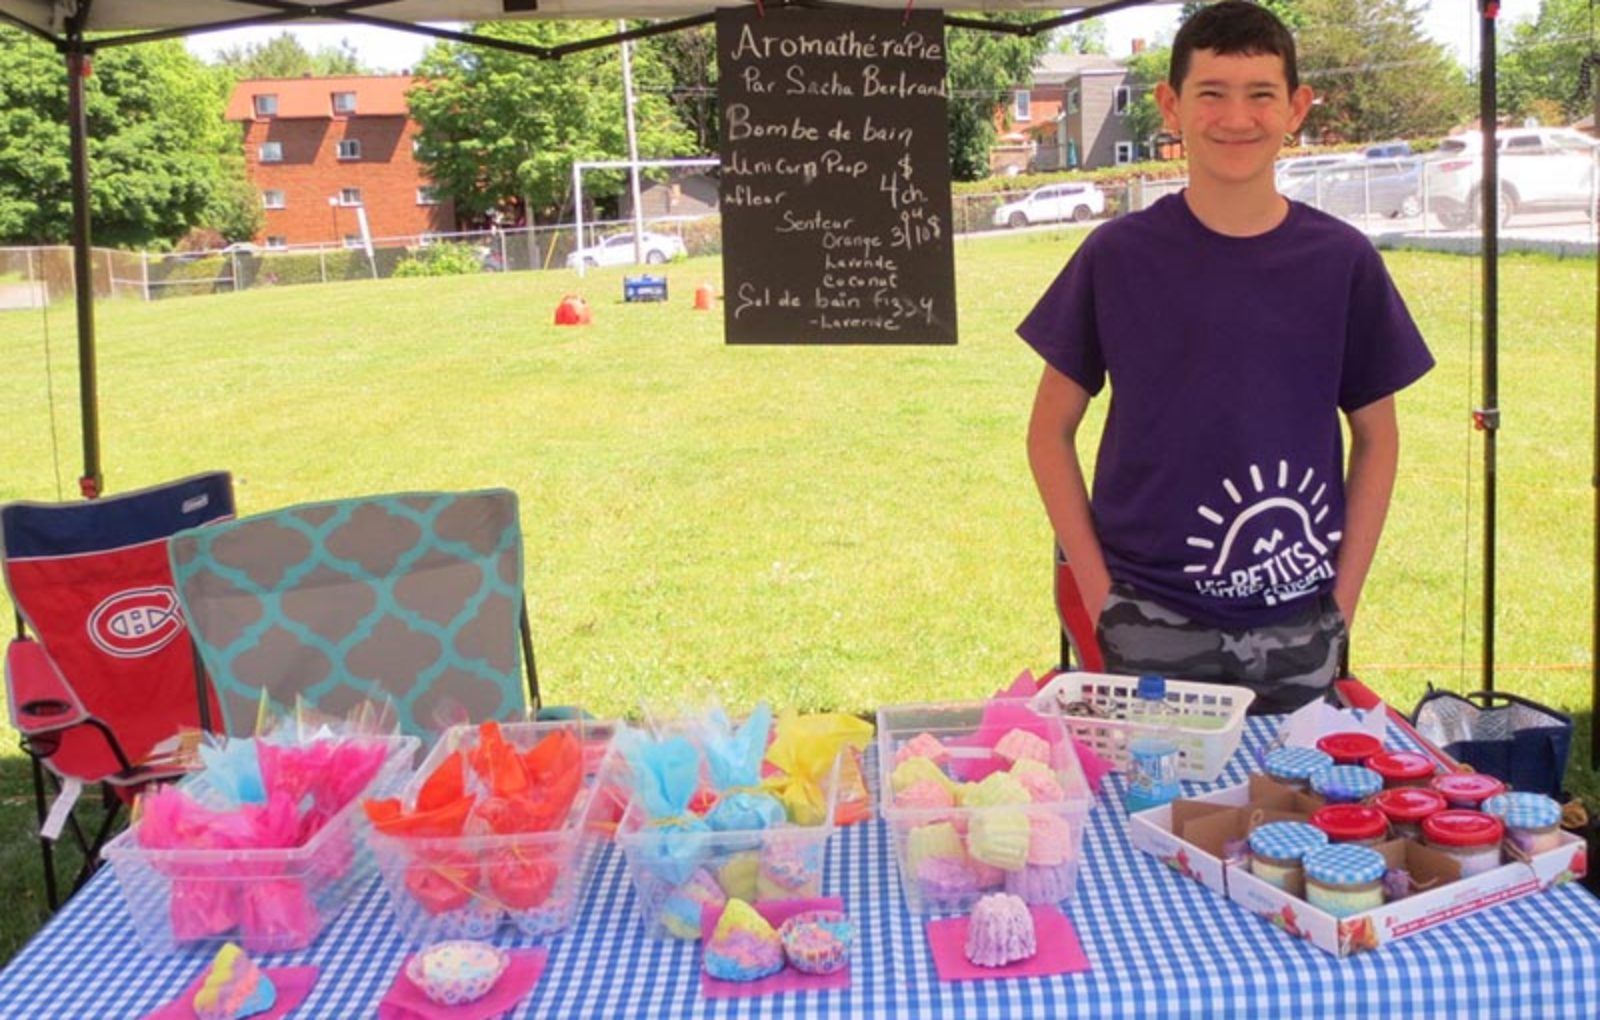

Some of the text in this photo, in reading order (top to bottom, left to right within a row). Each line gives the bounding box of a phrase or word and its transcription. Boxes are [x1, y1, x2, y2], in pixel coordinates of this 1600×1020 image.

[743, 64, 949, 98] Par Sacha Bertrand
[726, 103, 914, 147] Bombe de bain
[776, 210, 854, 233] Senteur
[822, 232, 883, 258] Orange
[778, 289, 801, 307] de
[815, 287, 860, 308] bain
